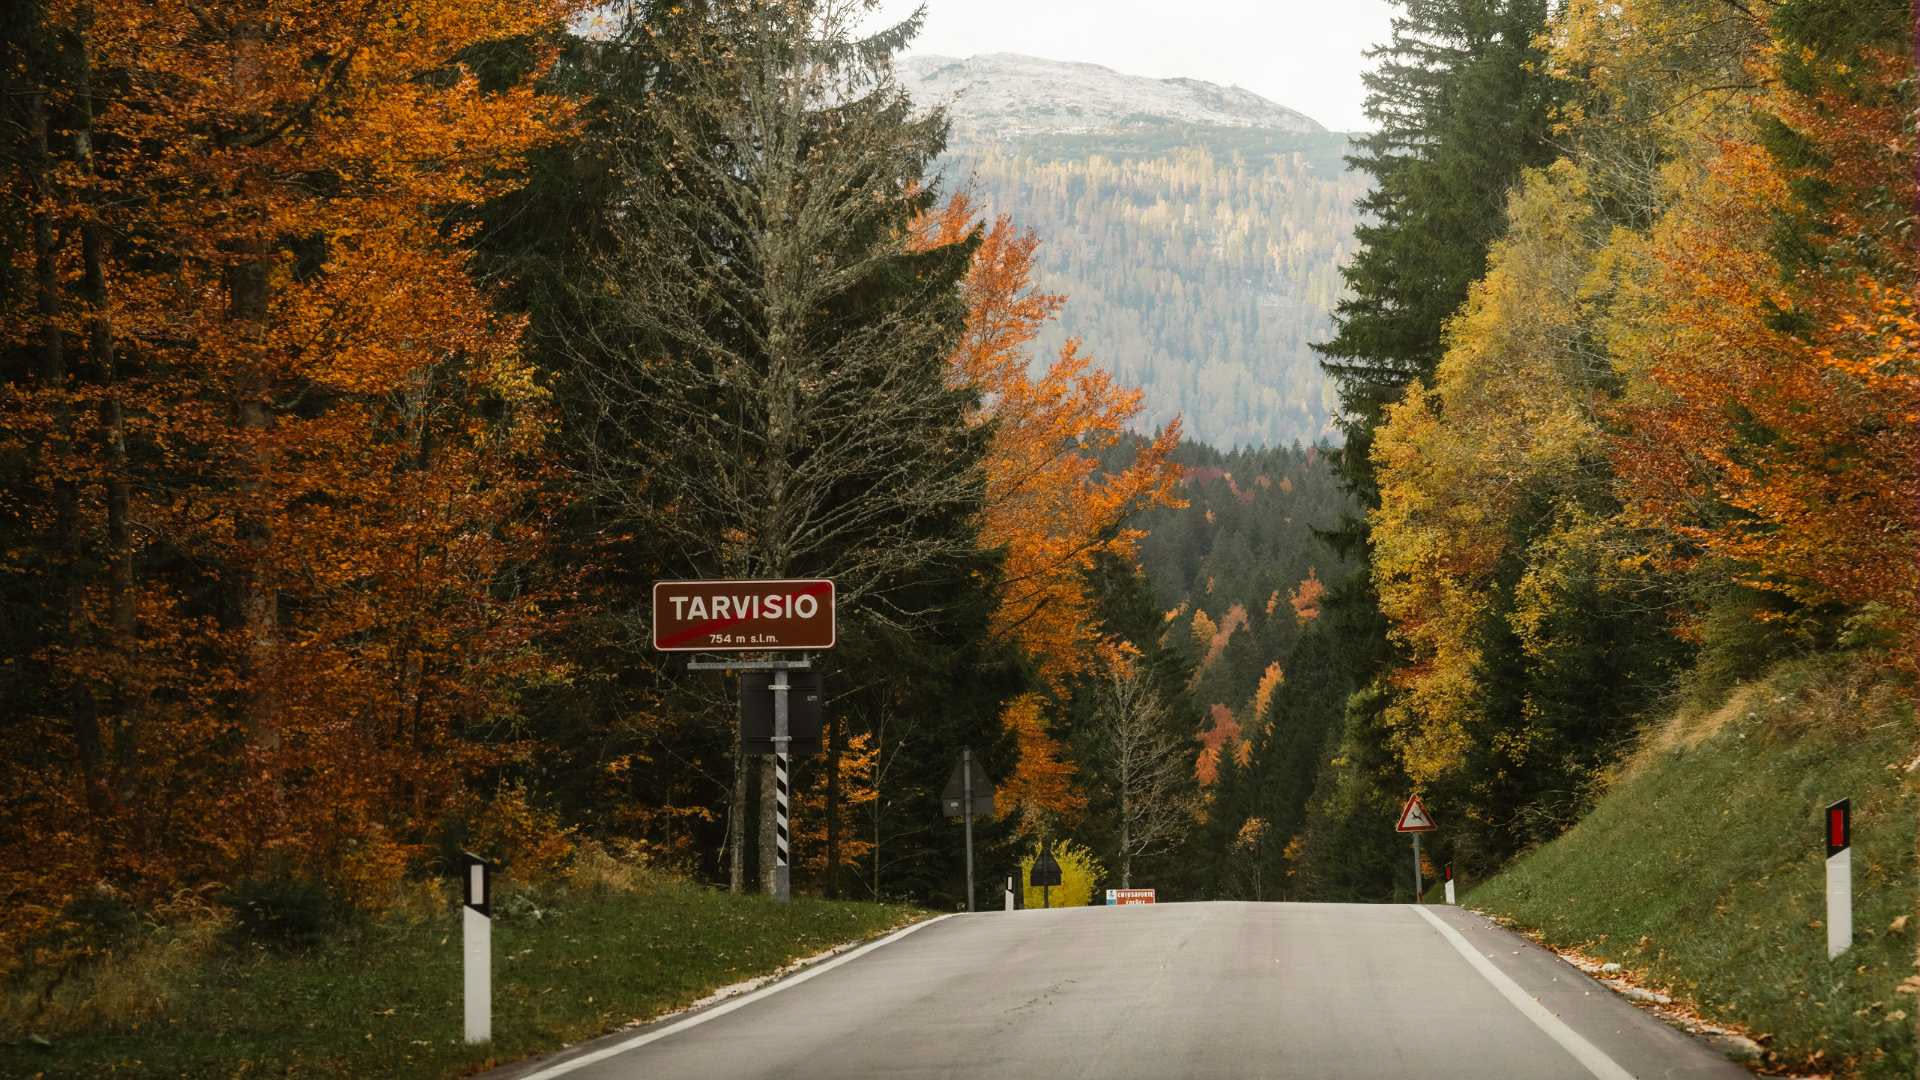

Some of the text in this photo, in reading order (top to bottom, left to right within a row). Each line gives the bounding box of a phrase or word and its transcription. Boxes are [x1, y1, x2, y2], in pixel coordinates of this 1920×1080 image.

[669, 594, 818, 620] TARVISIO
[709, 634, 779, 644] 754 m s.l.m.
